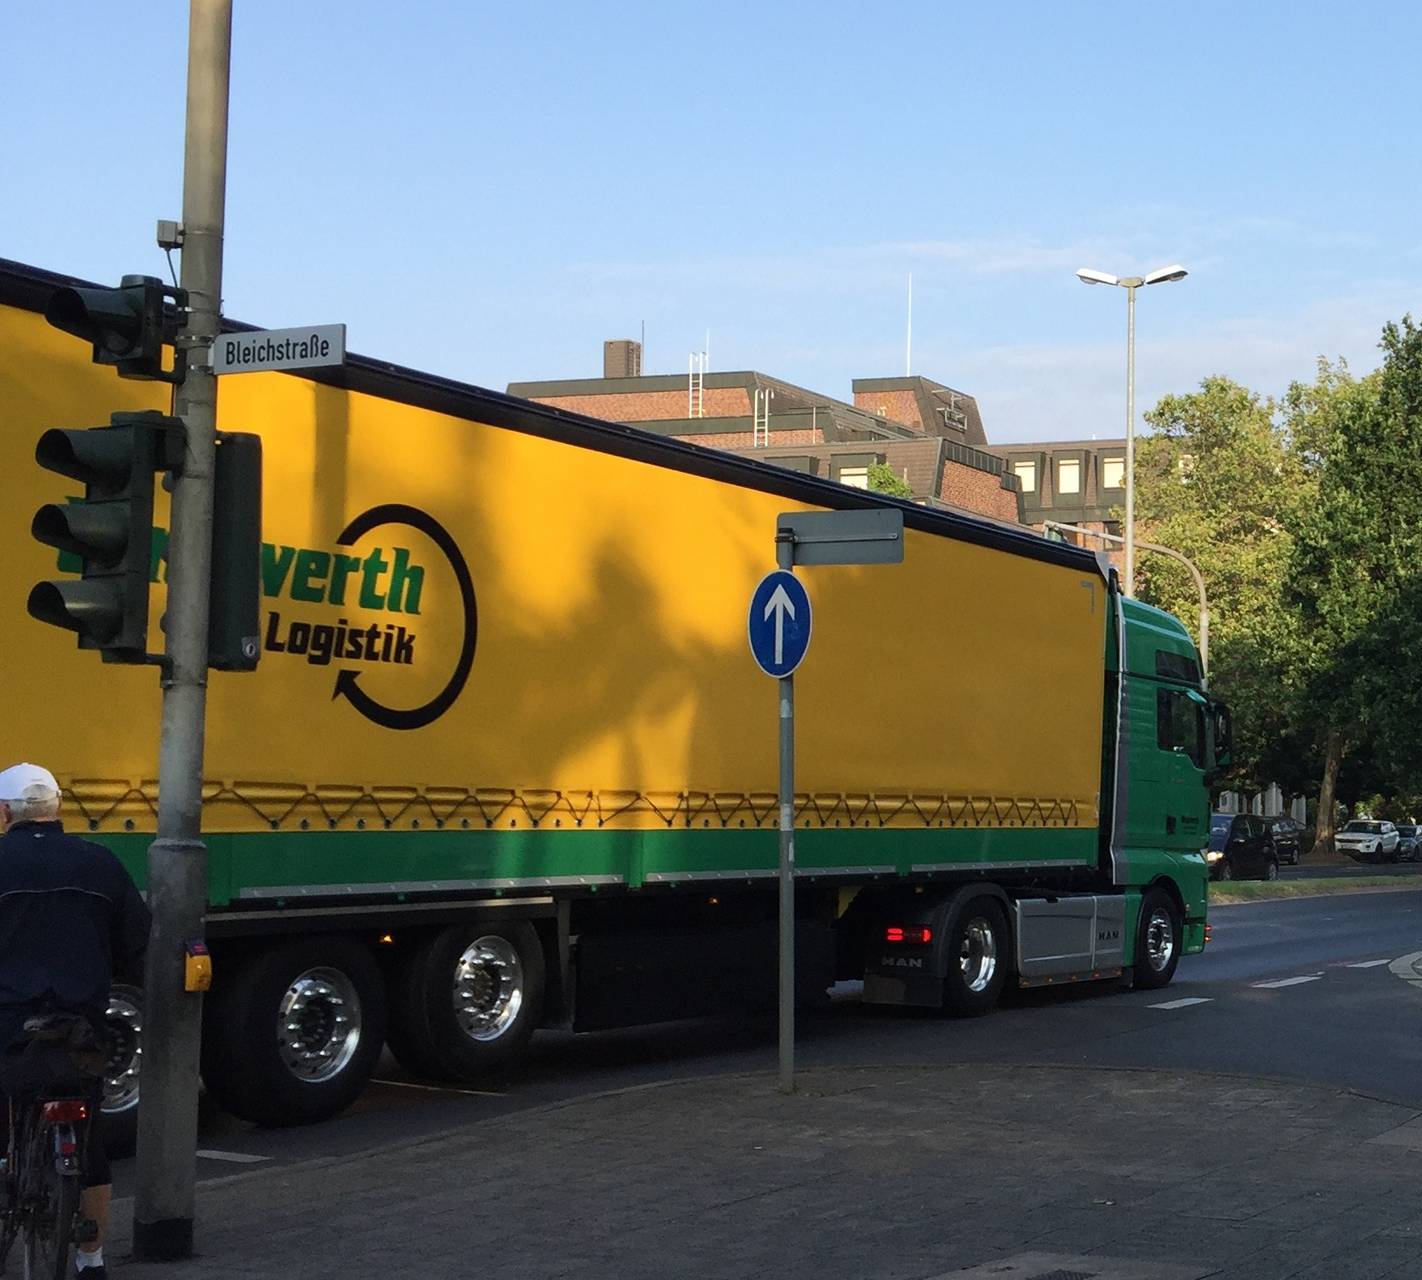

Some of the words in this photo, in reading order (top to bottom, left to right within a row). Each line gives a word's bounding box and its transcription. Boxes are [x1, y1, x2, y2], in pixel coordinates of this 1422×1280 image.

[225, 333, 330, 366] Bleichstraße
[265, 611, 416, 665] Logistik
[1098, 930, 1119, 940] MAN
[881, 957, 922, 968] MAN
